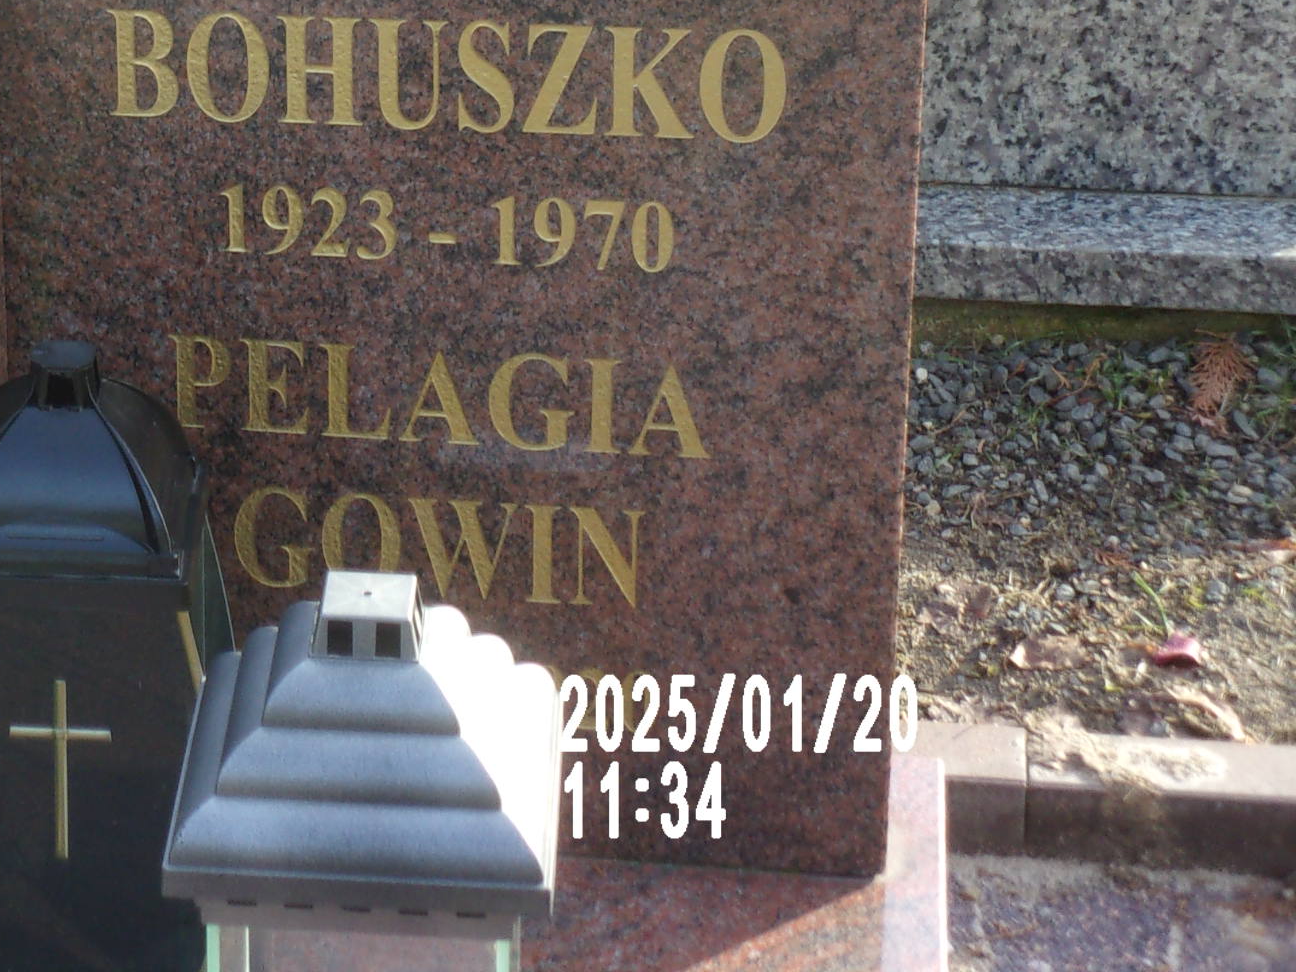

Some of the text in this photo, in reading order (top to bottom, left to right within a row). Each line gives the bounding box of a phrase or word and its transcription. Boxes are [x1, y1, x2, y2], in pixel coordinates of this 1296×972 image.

[106, 8, 787, 144] BOHUSZKO
[219, 183, 675, 273] 1923 - 1970
[168, 334, 711, 459] PELAGIA
[233, 486, 647, 609] GOWIN
